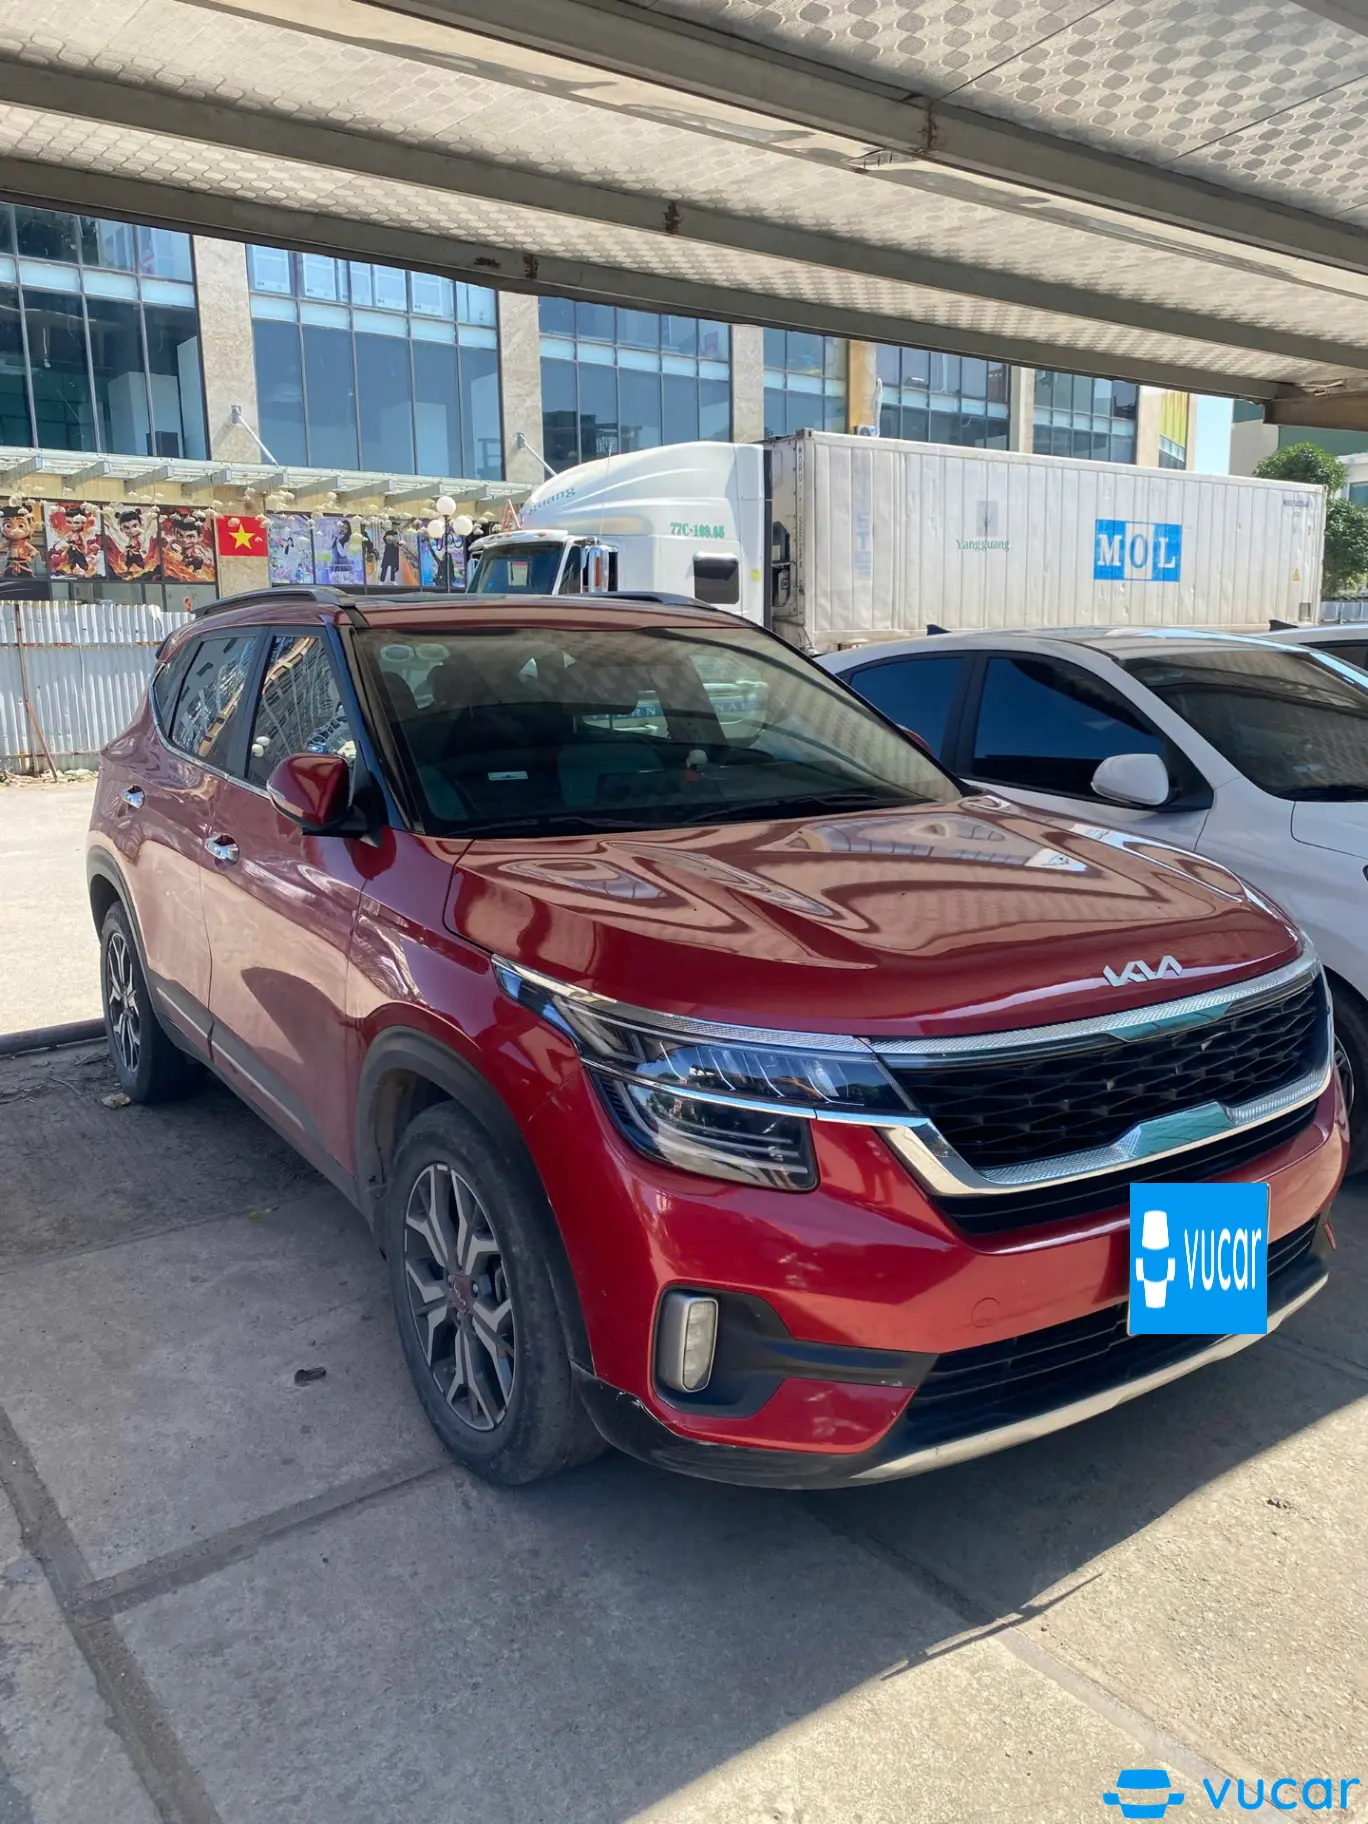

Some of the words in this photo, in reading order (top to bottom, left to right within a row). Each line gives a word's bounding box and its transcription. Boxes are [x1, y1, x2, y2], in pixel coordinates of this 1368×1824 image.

[955, 539, 1011, 553] Yangguang
[1097, 533, 1176, 569] MOL
[1103, 955, 1183, 987] KIA
